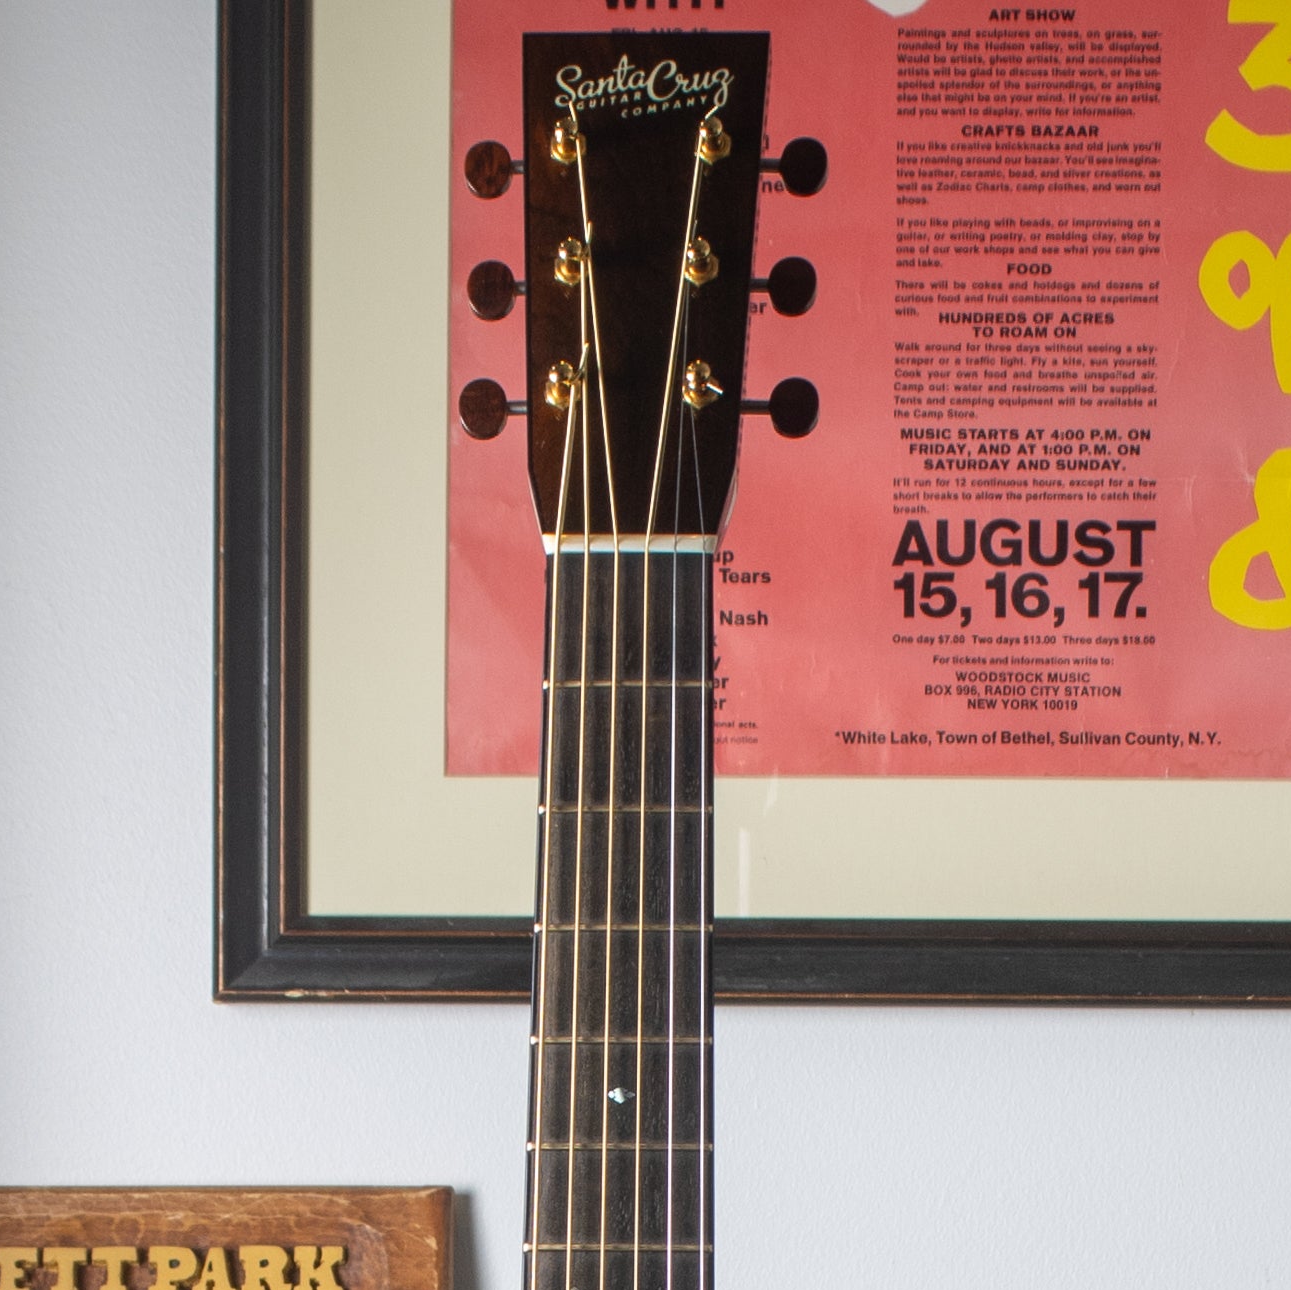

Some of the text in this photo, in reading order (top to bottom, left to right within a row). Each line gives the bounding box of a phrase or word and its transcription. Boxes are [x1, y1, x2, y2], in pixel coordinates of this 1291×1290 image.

[989, 9, 1076, 21] ART SHOW
[554, 54, 734, 108] Santa Cruz
[576, 92, 642, 110] GUITAR
[621, 95, 708, 118] COMPANY
[961, 124, 1099, 137] CRAFTS BAZAAR
[1006, 263, 1052, 276] FOOD
[938, 312, 1115, 324] HUNDREDS OF ACRES
[972, 326, 1077, 338] TO ROAM ON
[900, 428, 1151, 441] MUSIC STARTS AT 4:00 P.M. ON
[909, 444, 1141, 458] FRIDAY, AND AT 1:00 P.M. ON
[924, 459, 1126, 471] SATURDAY AND SUNDAY.
[892, 518, 1156, 568] AUGUST
[718, 568, 772, 584] Tears
[892, 571, 1147, 628] 15, 16, 17.
[719, 610, 769, 626] Nash
[955, 672, 1091, 684] WOODSTOCK MUSIC
[924, 685, 952, 697] BOX
[984, 686, 1026, 697] RADIO
[1030, 686, 1061, 697] CITY
[1065, 686, 1122, 697] STATION
[967, 699, 1078, 711] NEW YORK 10019
[891, 731, 933, 747] Lake,
[936, 731, 977, 745] Town
[981, 730, 997, 745] of
[1002, 730, 1055, 748] Bethel,
[1059, 731, 1121, 746] Sullivan
[1125, 731, 1185, 749] County,
[1188, 732, 1222, 746] N.Y.
